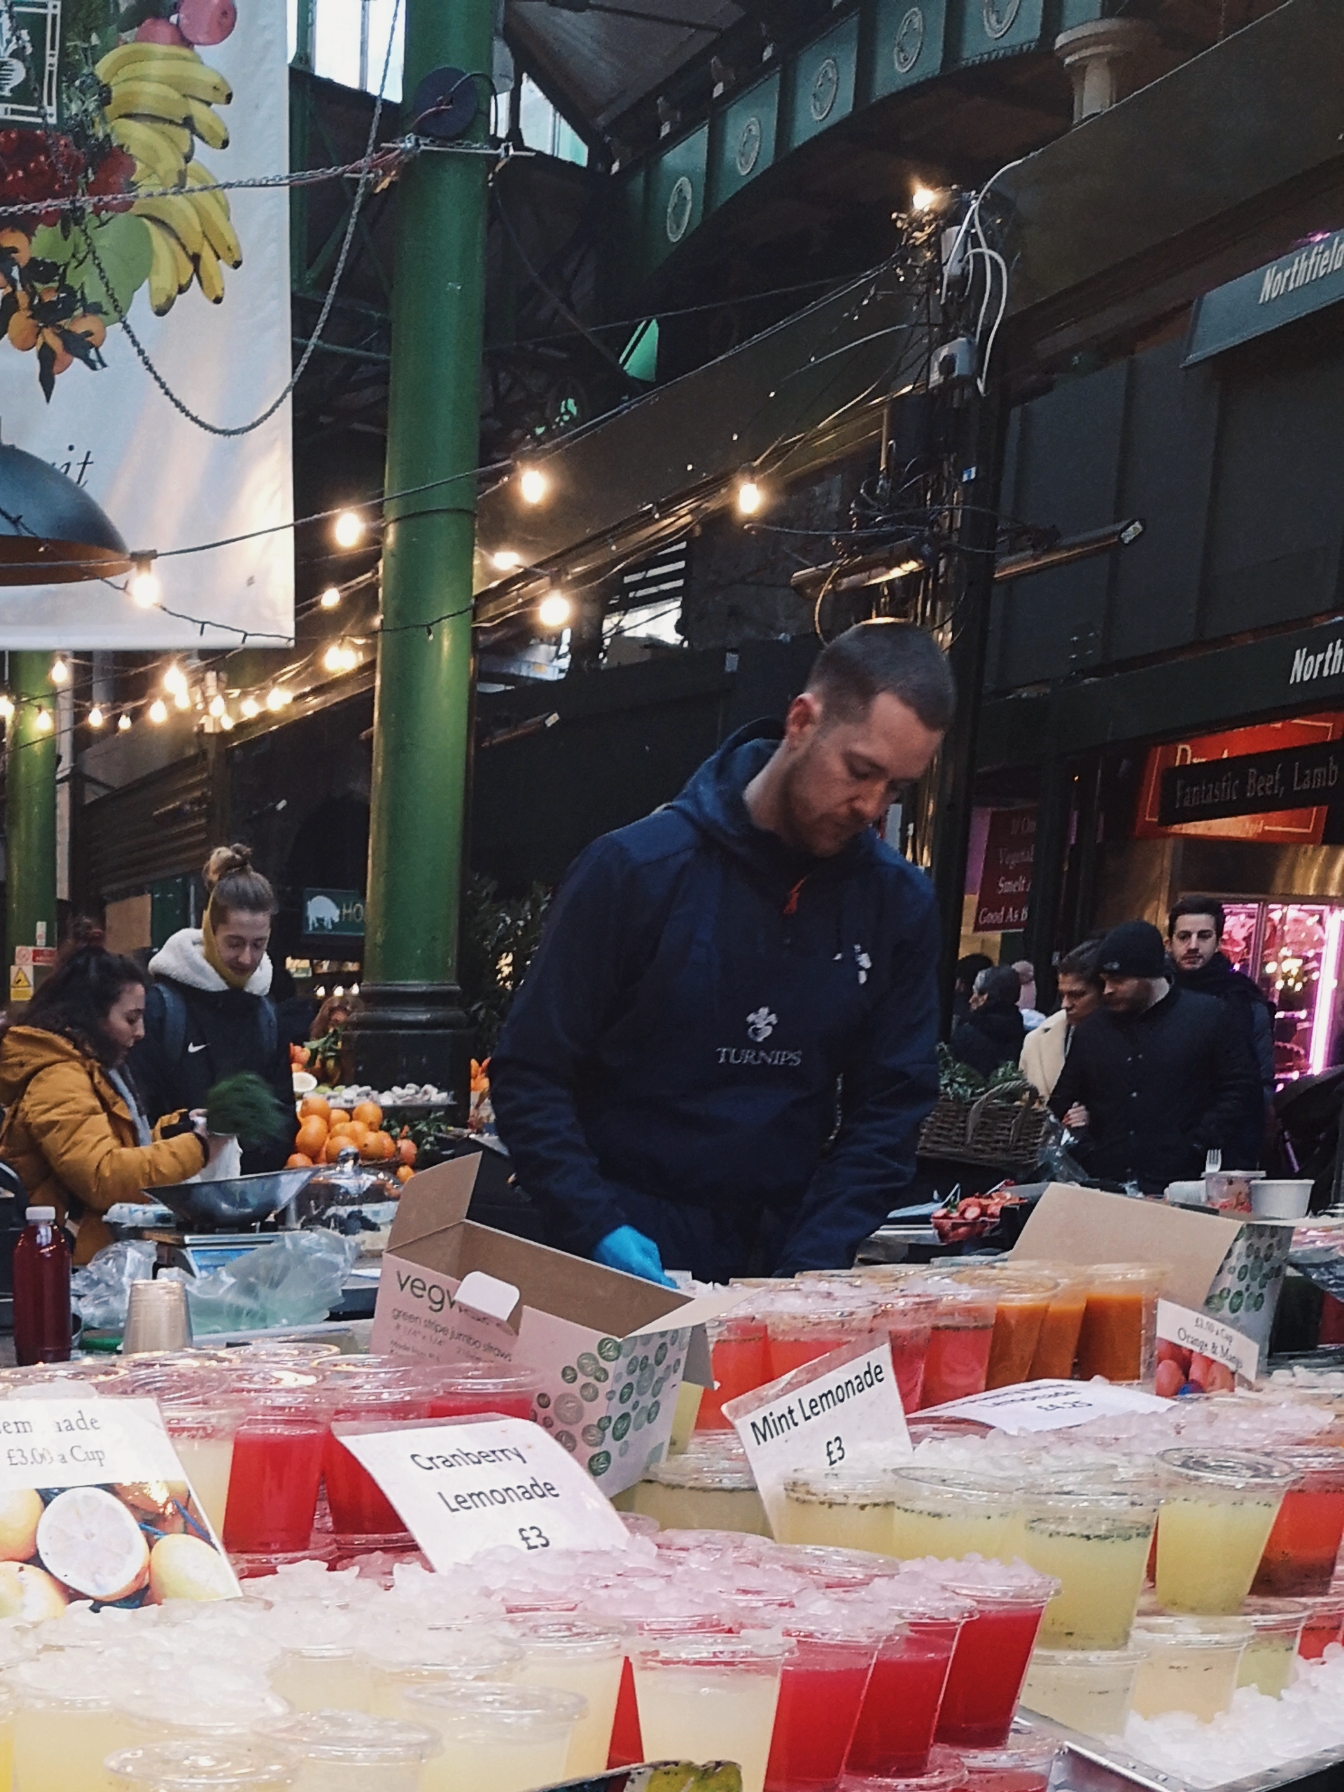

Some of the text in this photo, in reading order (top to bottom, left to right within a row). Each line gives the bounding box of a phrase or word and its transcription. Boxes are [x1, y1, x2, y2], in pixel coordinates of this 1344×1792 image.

[1293, 754, 1340, 790] Lamb
[997, 874, 1027, 894] Smelt
[979, 905, 1005, 925] Good
[1005, 906, 1019, 923] As
[715, 1047, 803, 1067] TURNIPS
[391, 1307, 422, 1326] green
[449, 1326, 482, 1350] jumbo
[1177, 1327, 1208, 1355] Orange
[750, 1405, 799, 1445] Mint
[798, 1360, 885, 1422] Lemonade
[58, 1451, 67, 1464] a
[69, 1445, 106, 1467] Cup
[409, 1444, 527, 1472] Cranberry
[825, 1435, 846, 1466] £3
[437, 1476, 560, 1513] Lemonade
[518, 1525, 551, 1551] £3
